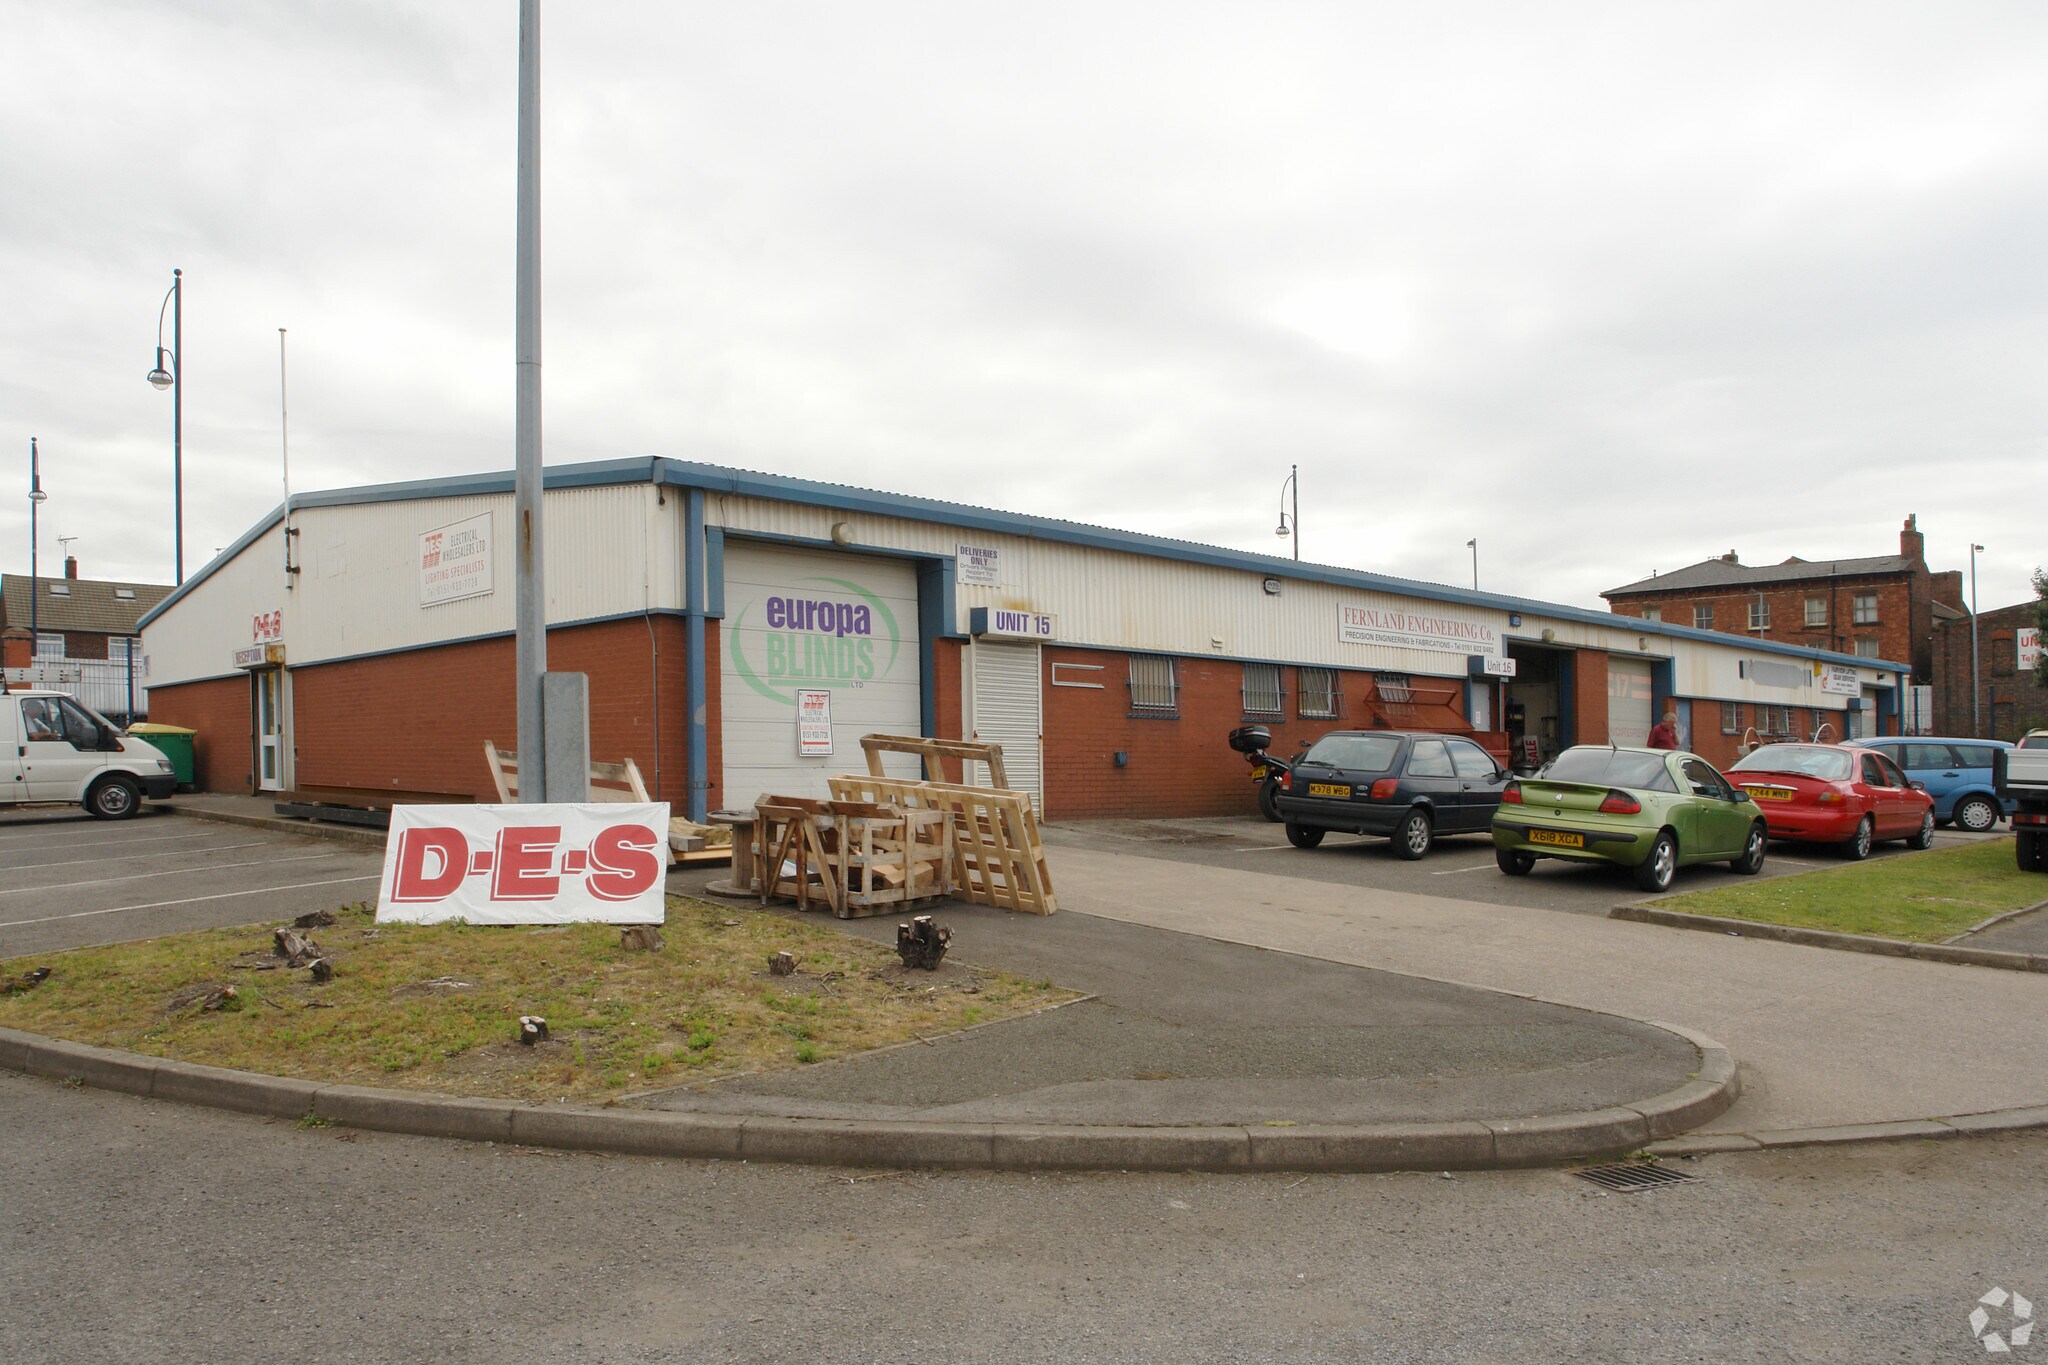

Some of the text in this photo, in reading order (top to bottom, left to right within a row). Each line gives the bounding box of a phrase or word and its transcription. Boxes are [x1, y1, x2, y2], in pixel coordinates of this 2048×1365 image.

[450, 528, 478, 547] ELECTRICAL
[442, 539, 486, 562] WHOLESALERS LTD
[960, 546, 998, 559] DELIVERIES
[960, 563, 980, 571] Drivers
[970, 556, 988, 566] ONLY
[425, 559, 485, 584] LIGHTING SPECIALISTS
[966, 574, 994, 582] Reception
[767, 596, 871, 637] europa
[996, 611, 1050, 635] UNIT 15
[1344, 607, 1495, 641] FERNLAND ENGINEERING Co.
[1345, 630, 1375, 641] PRECISION
[1375, 634, 1410, 645] ENGINEERING
[1415, 638, 1451, 649] FABRICATIONS
[235, 648, 262, 665] RECEPTION
[767, 632, 875, 680] BLINDS
[1487, 660, 1512, 673] Unit 16
[851, 681, 864, 689] LTD
[1525, 740, 1539, 764] SALE
[1310, 785, 1331, 794] M378
[1333, 786, 1349, 796] WBG
[1533, 831, 1556, 842] X618
[391, 824, 659, 903] D-E-S
